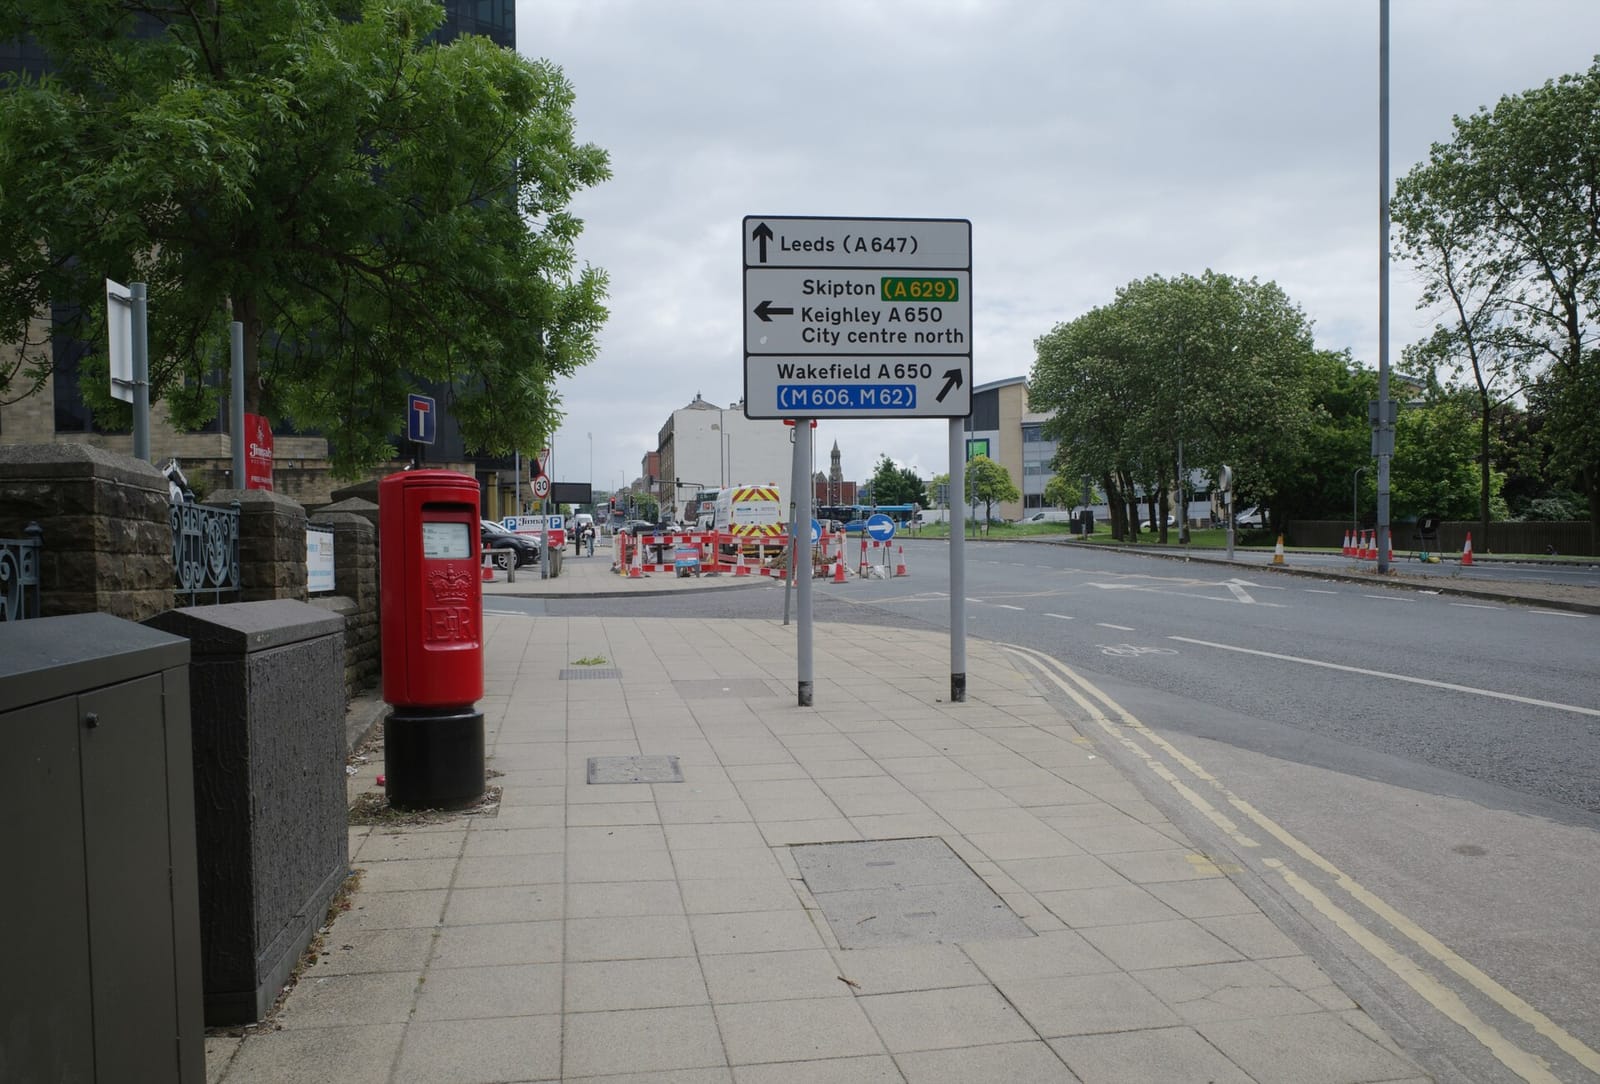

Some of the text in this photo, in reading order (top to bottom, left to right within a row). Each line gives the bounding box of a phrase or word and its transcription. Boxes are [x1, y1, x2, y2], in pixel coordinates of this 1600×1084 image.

[780, 235, 835, 252] Leeds
[802, 279, 876, 298] Skipton
[801, 306, 881, 325] Keighley
[801, 327, 964, 346] City centre north
[776, 363, 871, 380] Wakefield
[536, 480, 548, 492] 30
[507, 520, 516, 530] P
[552, 517, 560, 528] P
